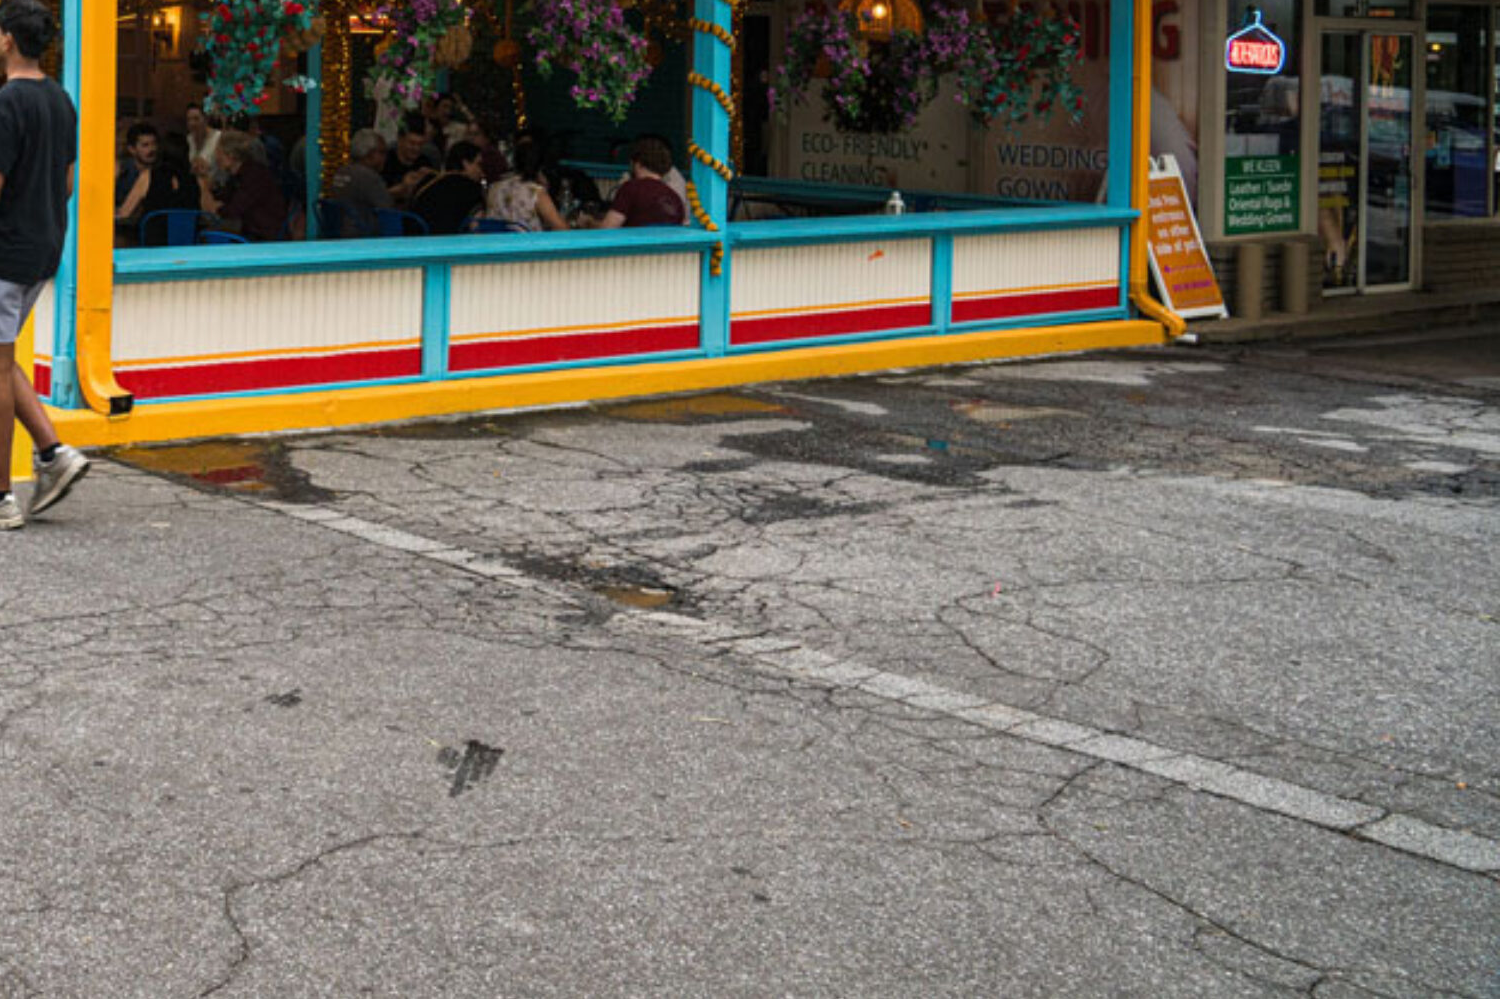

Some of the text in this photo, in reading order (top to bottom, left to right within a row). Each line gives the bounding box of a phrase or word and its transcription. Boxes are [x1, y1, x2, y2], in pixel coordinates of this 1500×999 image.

[998, 144, 1108, 170] WEDDING
[1229, 197, 1261, 211] Oriental
[1228, 212, 1264, 228] Wedding
